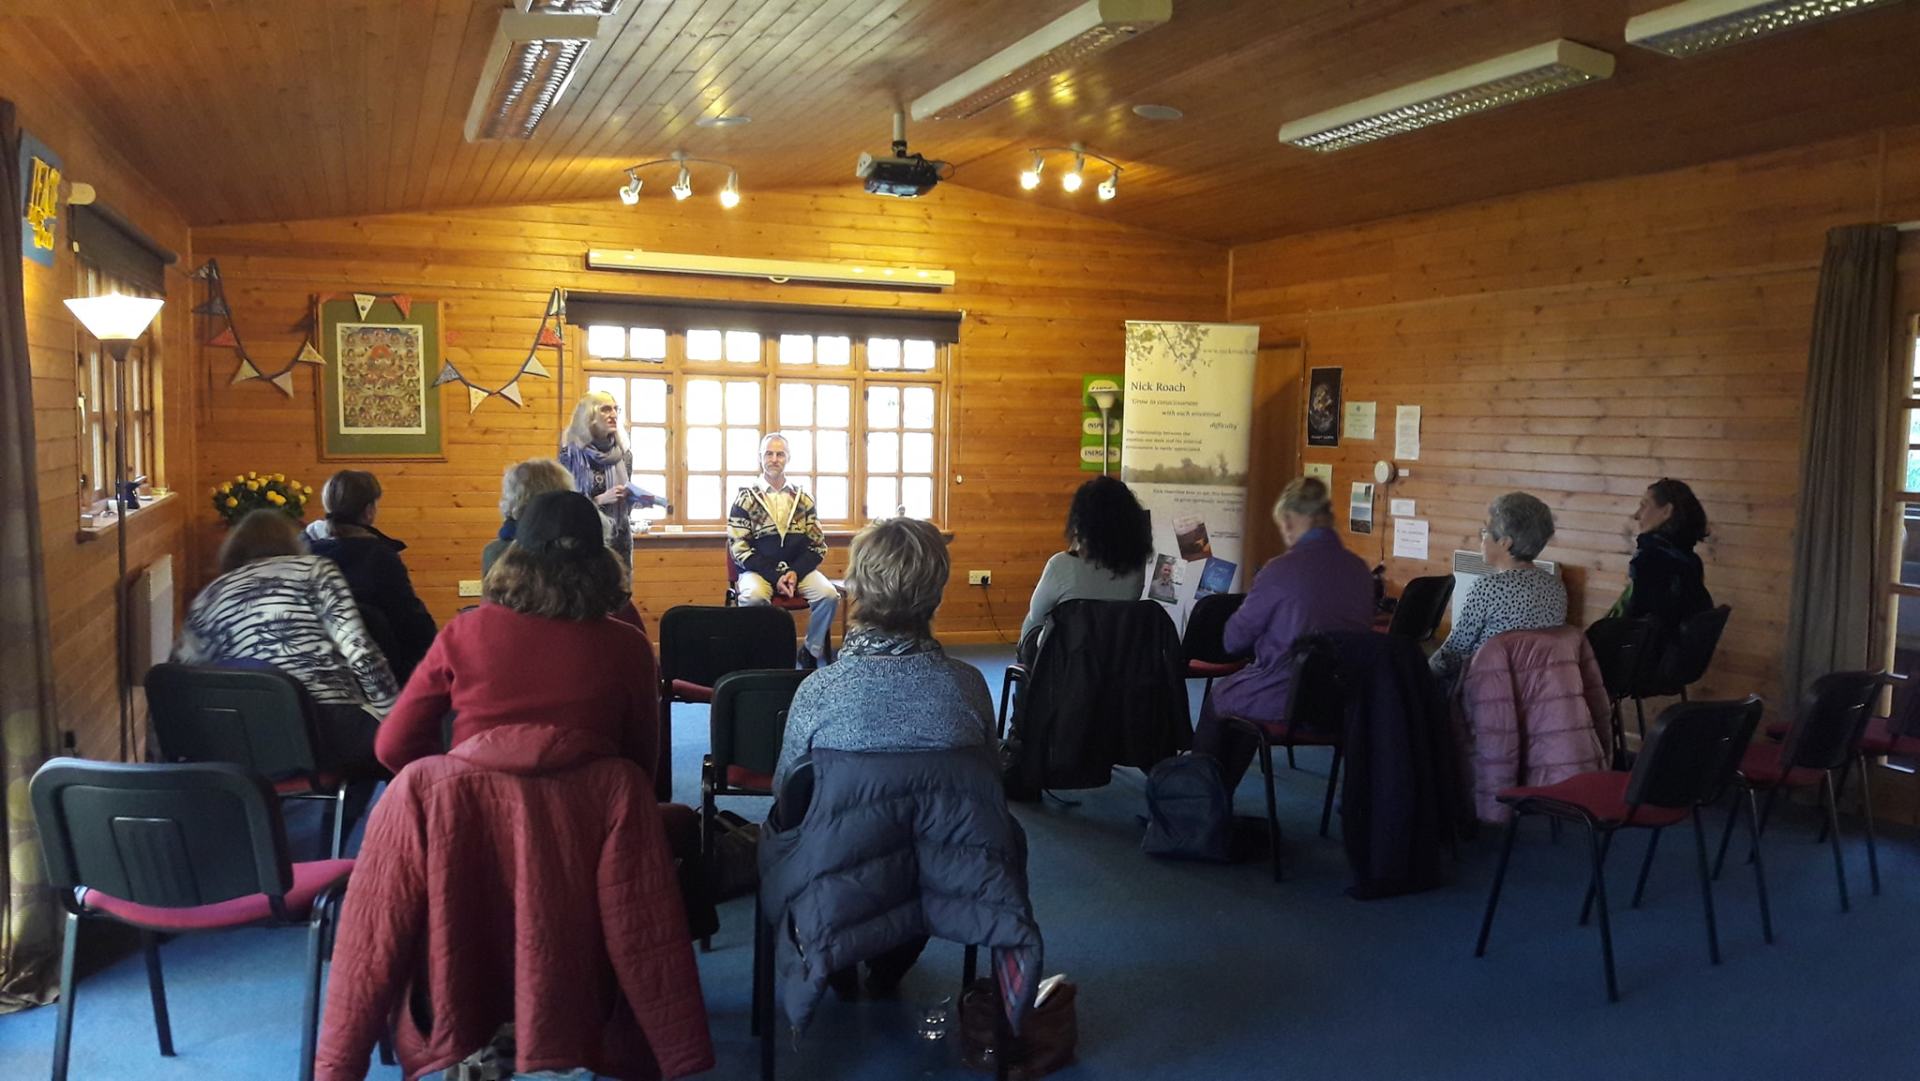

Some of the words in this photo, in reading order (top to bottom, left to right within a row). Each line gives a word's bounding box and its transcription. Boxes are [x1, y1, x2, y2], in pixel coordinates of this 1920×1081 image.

[1131, 381, 1153, 392] Nick
[1156, 382, 1186, 393] Roach
[1162, 409, 1176, 417] with
